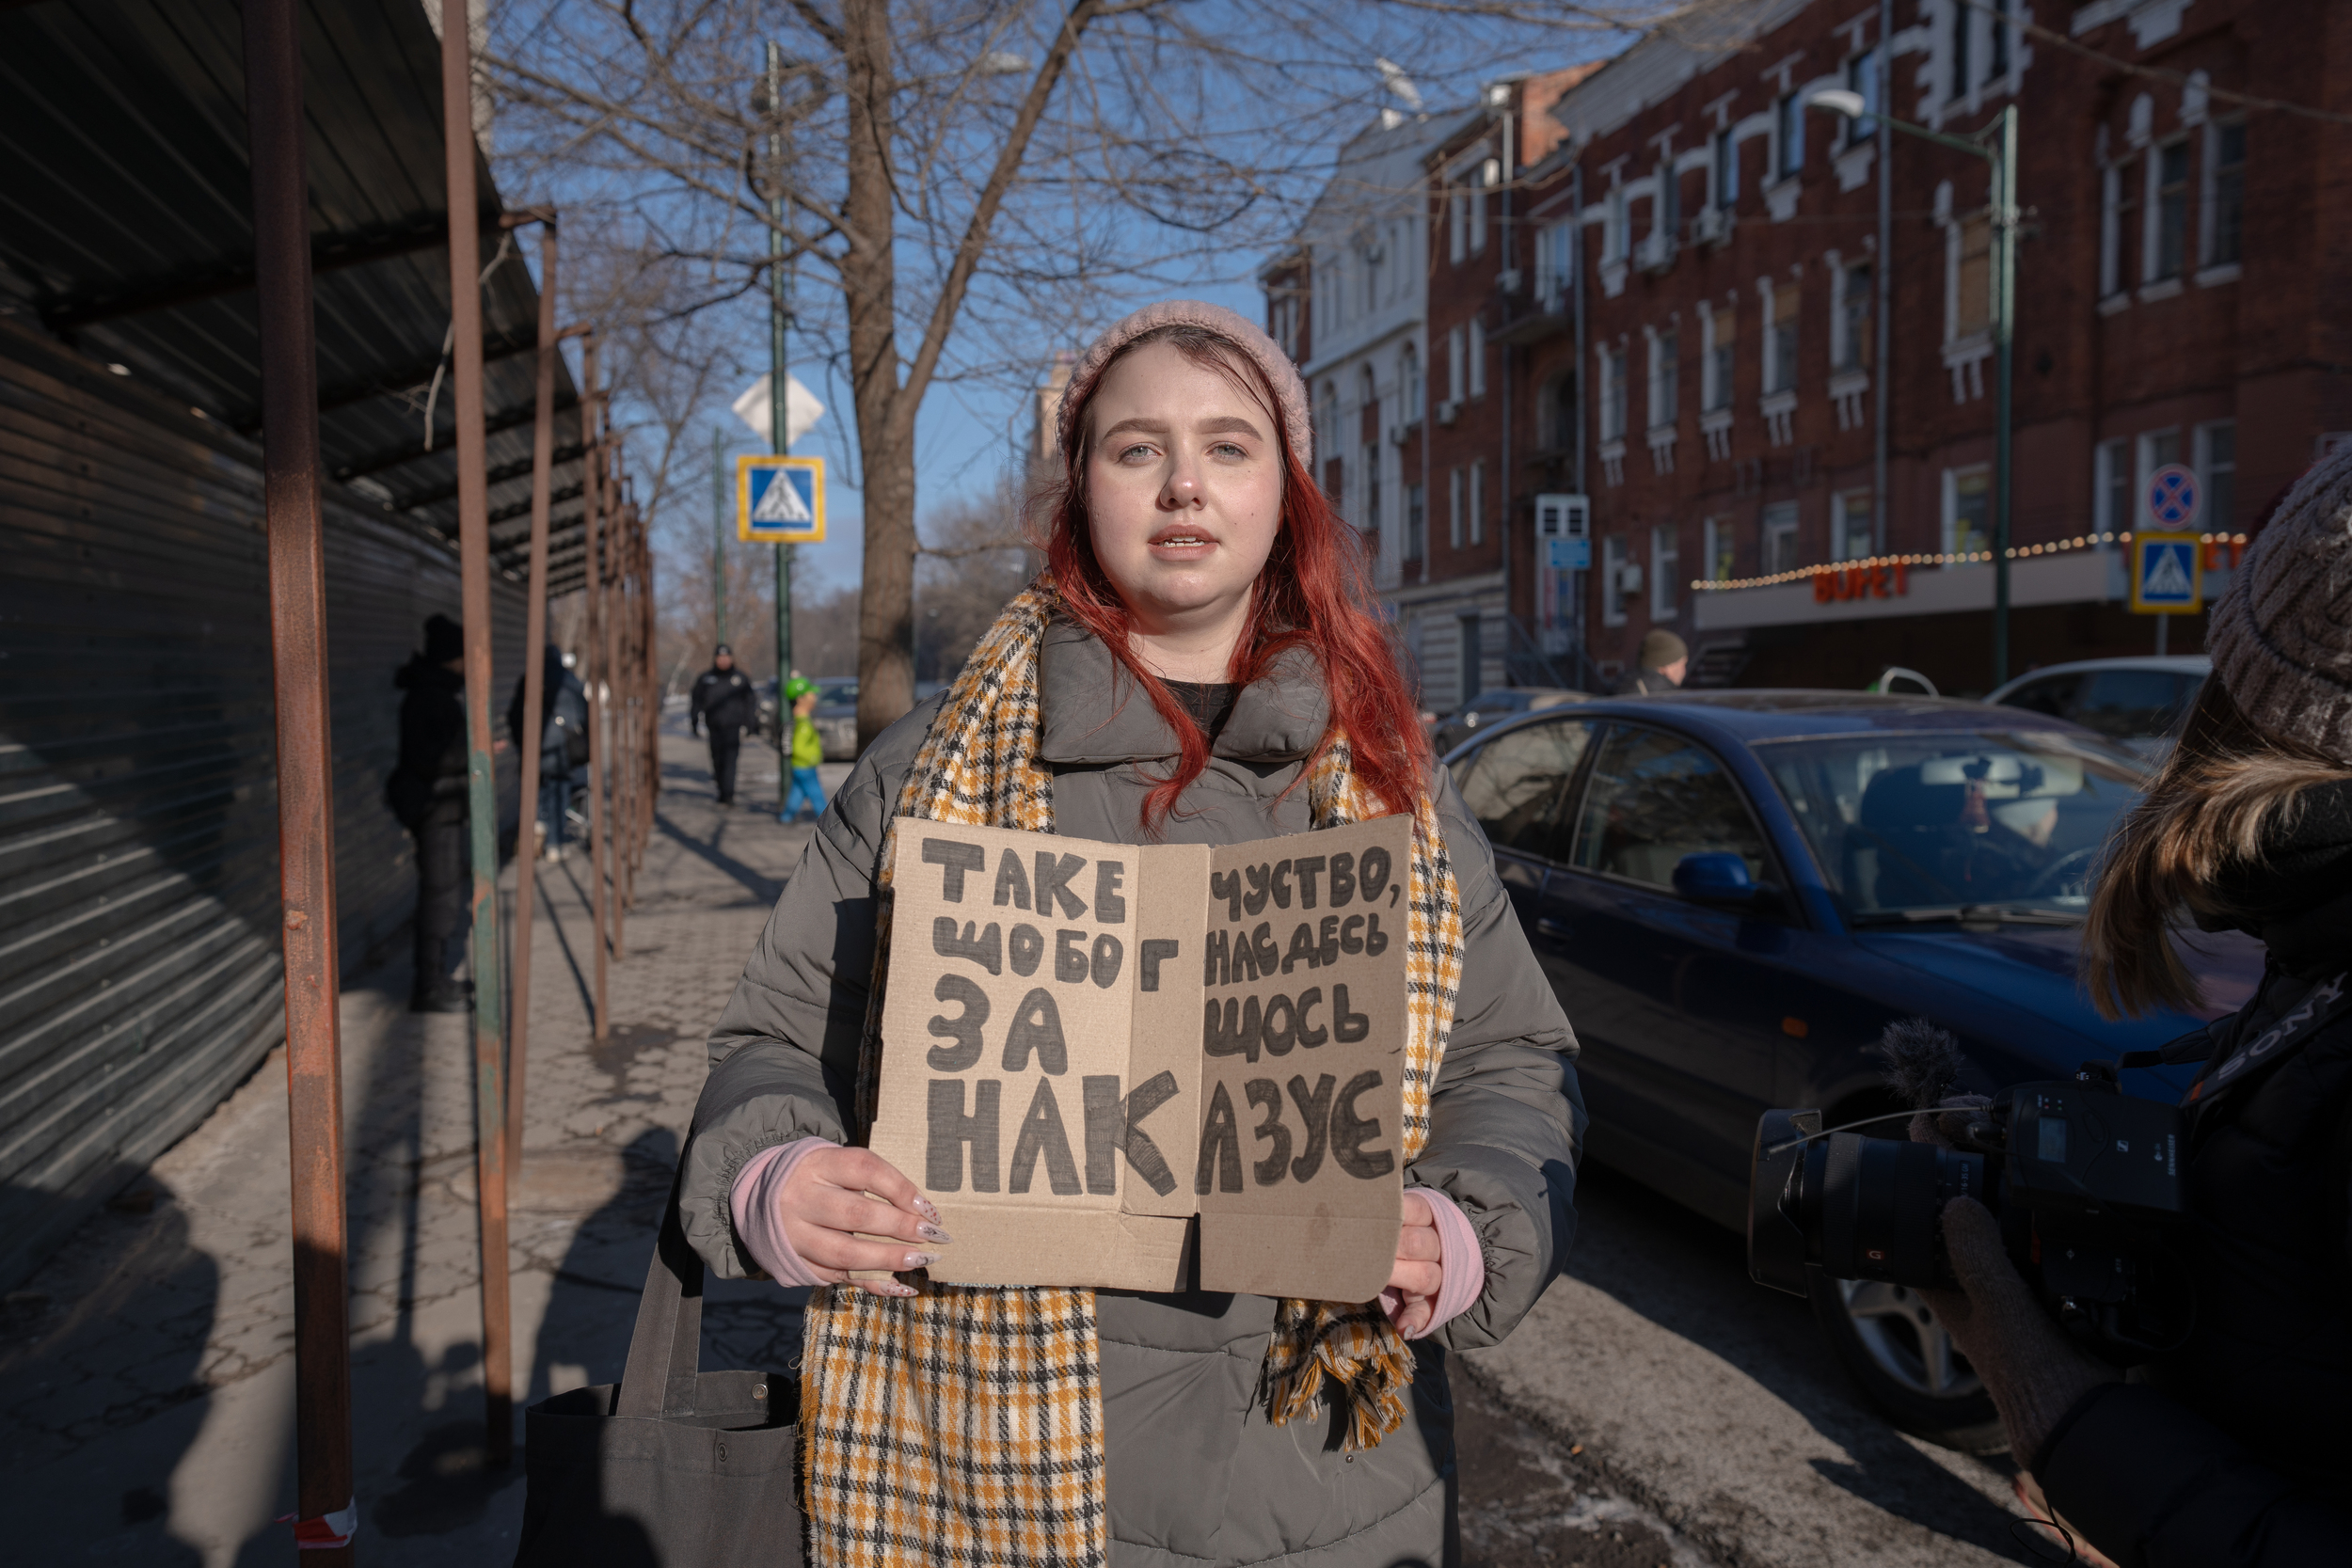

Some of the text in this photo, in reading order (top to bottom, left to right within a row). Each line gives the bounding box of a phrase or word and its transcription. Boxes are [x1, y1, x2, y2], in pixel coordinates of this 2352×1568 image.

[922, 837, 1401, 925] ТАКЕ ЧУСТВО,
[926, 973, 1370, 1076] ЗА ЩОСЬ
[2217, 971, 2348, 1081] SONY
